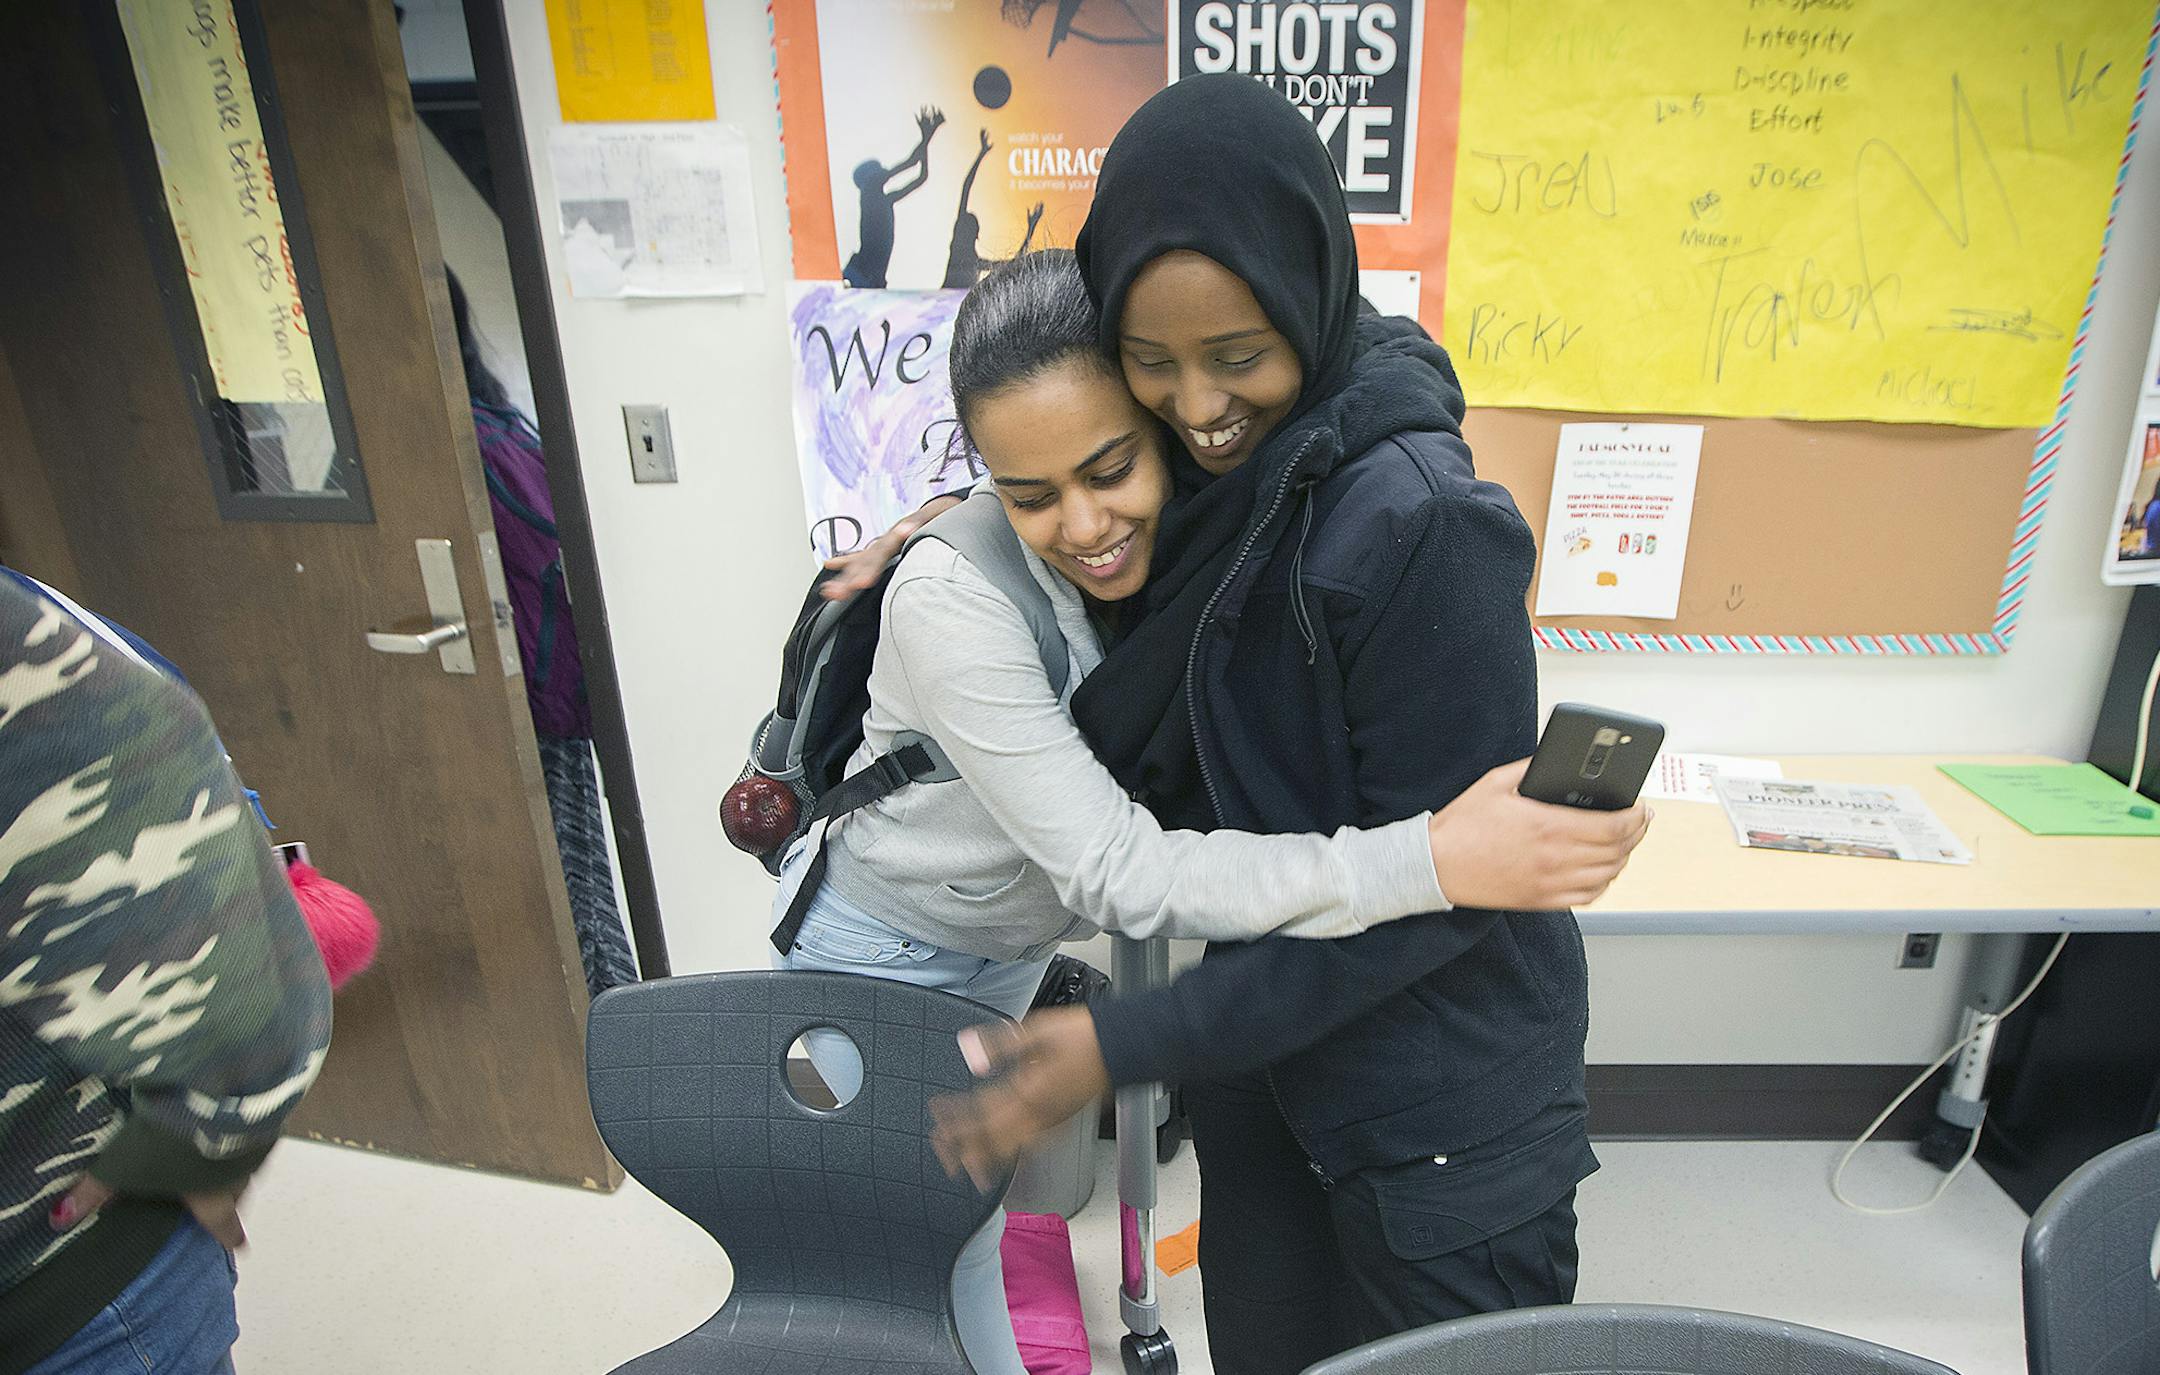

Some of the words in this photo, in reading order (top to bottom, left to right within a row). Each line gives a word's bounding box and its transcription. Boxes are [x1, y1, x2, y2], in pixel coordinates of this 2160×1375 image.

[1194, 2, 1397, 76] SHOTS
[207, 56, 242, 133] make
[1284, 74, 1375, 106] DON'T
[228, 139, 262, 221] better
[243, 235, 279, 294] pets
[269, 303, 292, 361] than
[806, 318, 932, 394] We
